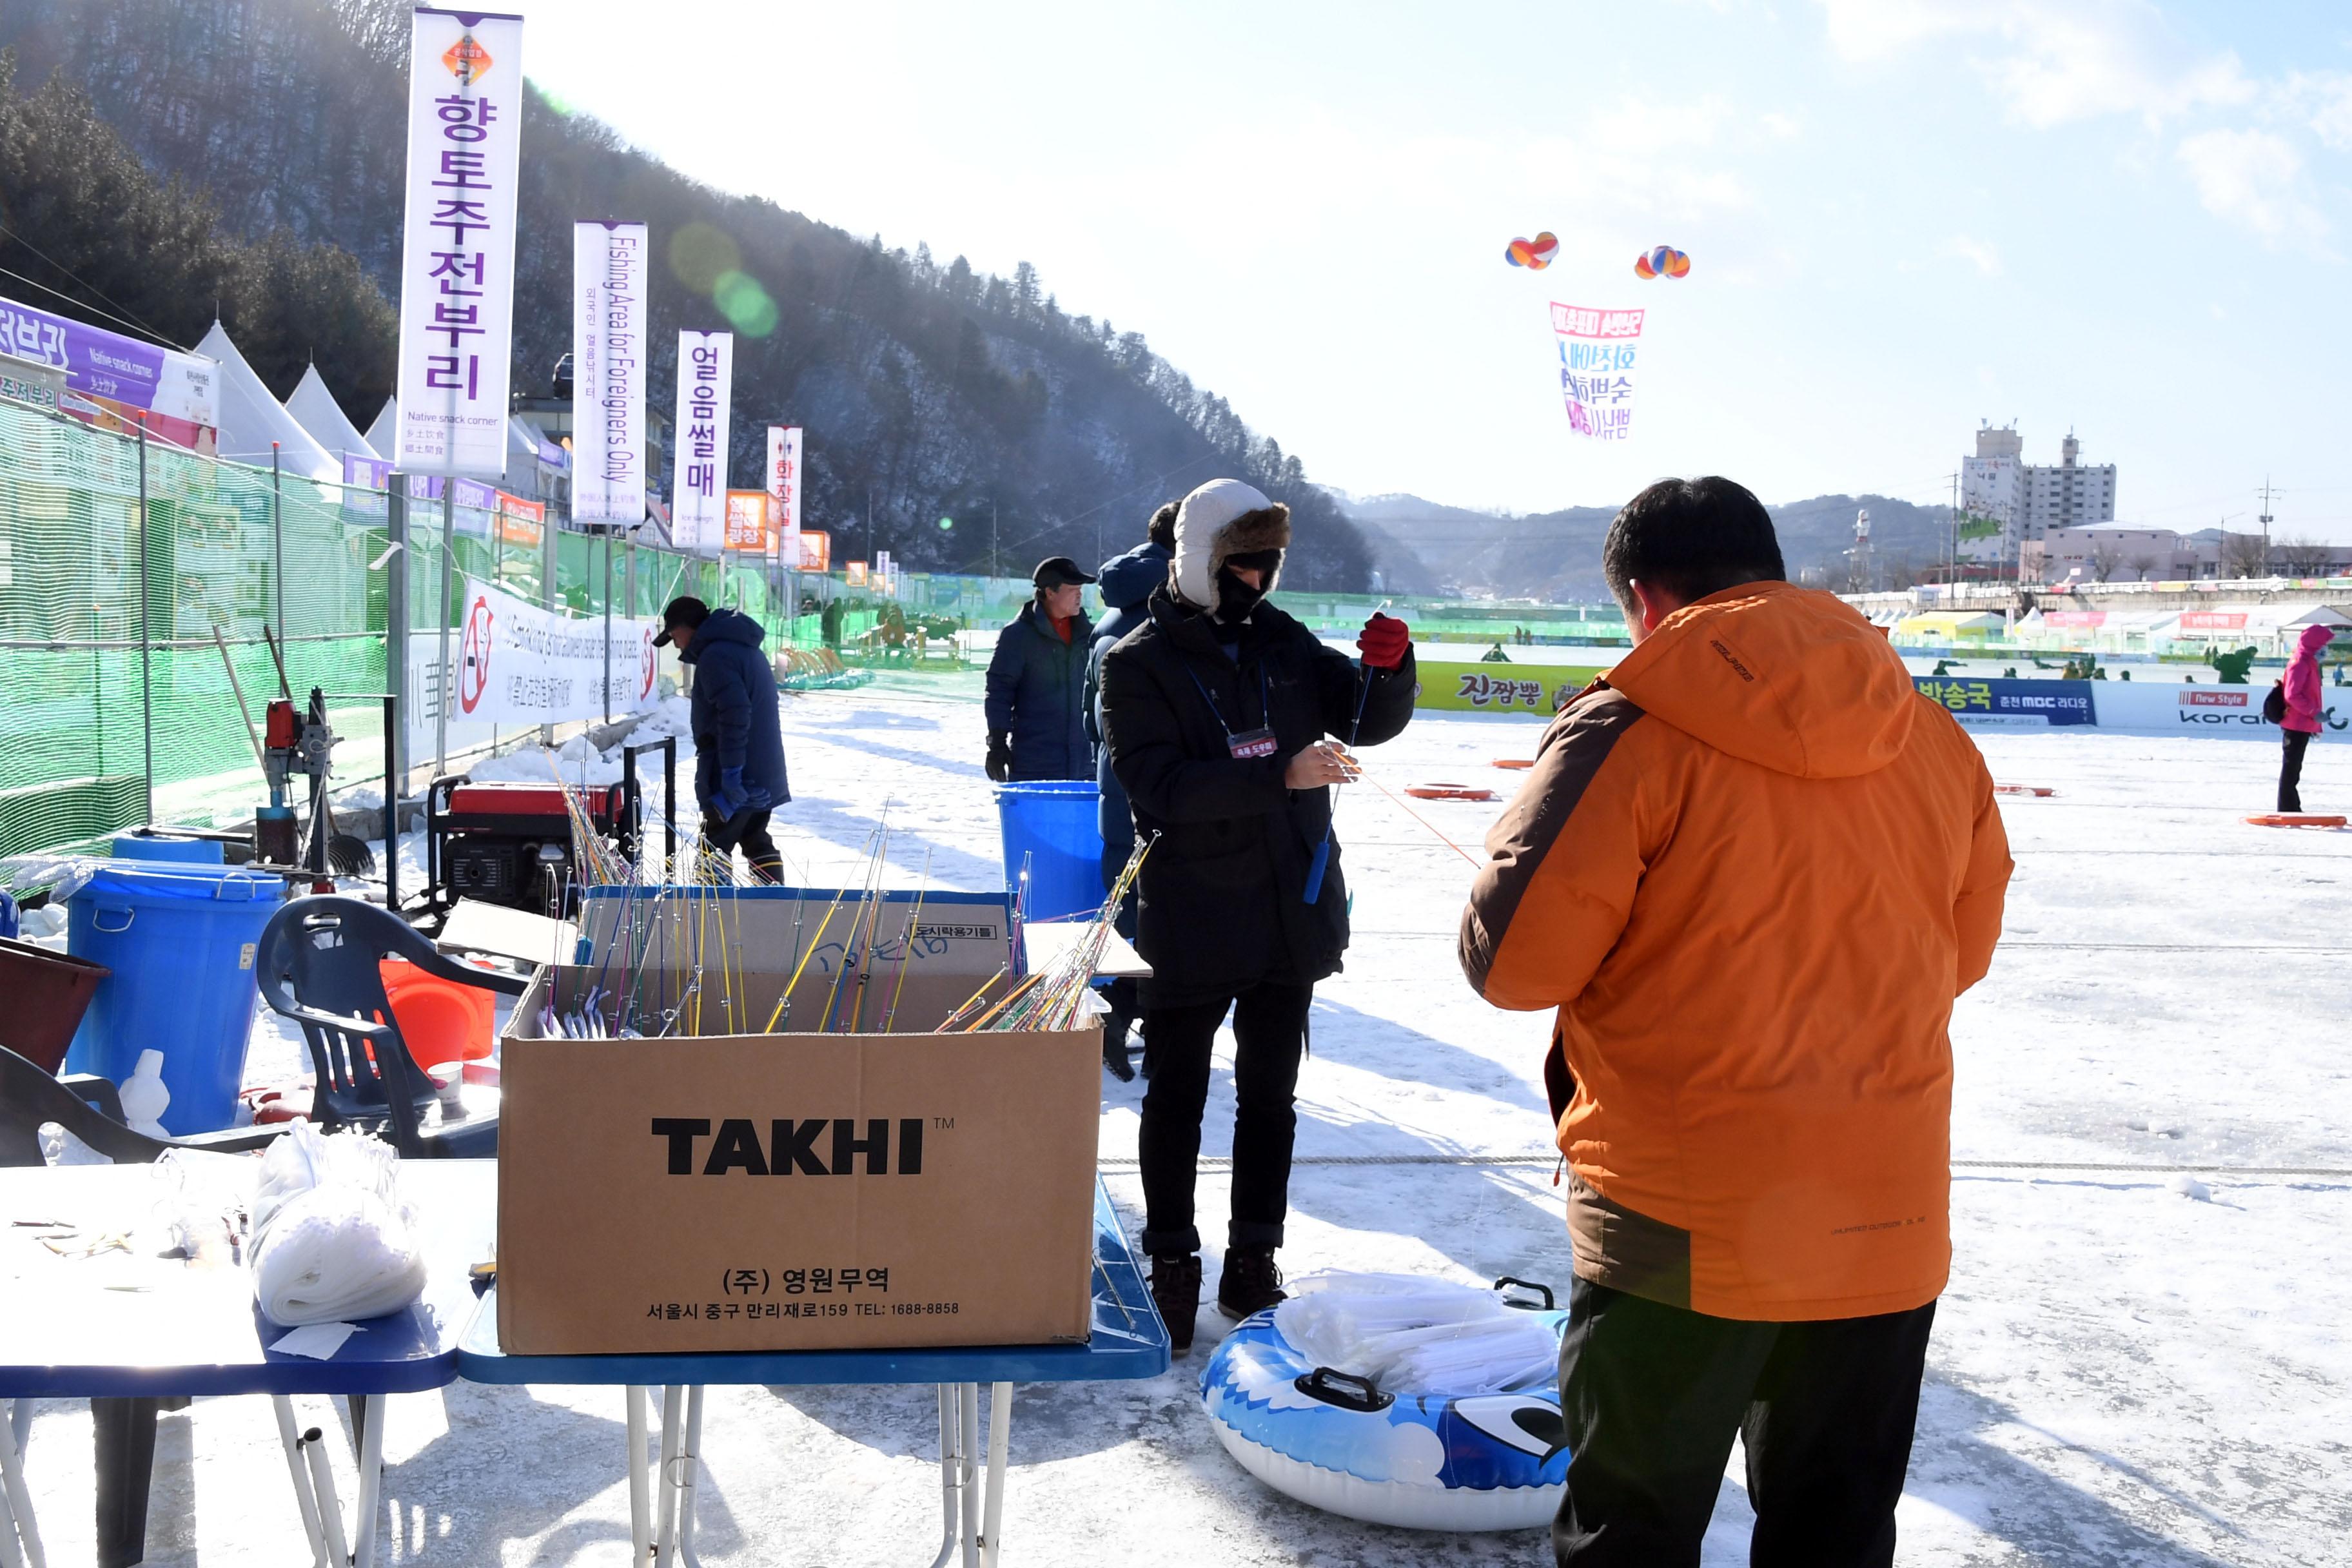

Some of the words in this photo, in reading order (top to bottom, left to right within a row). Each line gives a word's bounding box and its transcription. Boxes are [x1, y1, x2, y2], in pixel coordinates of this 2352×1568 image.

[426, 94, 498, 400] 향토주전부리
[602, 237, 636, 290] Fishing
[585, 288, 596, 326] 외국인
[608, 293, 636, 328] Area
[608, 333, 635, 354] for
[585, 334, 596, 398] 얼음낚시터
[407, 411, 437, 422] Native
[439, 416, 466, 424] snack
[467, 417, 498, 426] corner
[601, 358, 635, 445] Foreigners
[687, 347, 718, 497] 얼음썰매
[600, 451, 634, 484] Only
[776, 460, 794, 527] 화장실
[1456, 673, 1542, 707] 진짬뽕
[2022, 697, 2055, 708] MBC
[2057, 697, 2088, 709] 라디오
[2195, 693, 2215, 703] New
[2218, 694, 2242, 705] Style
[652, 1118, 923, 1175] TAKHI
[934, 1117, 954, 1130] TM
[723, 1268, 770, 1295] (주)
[783, 1268, 889, 1295] 영원무역
[647, 1303, 699, 1320] 서울시
[705, 1303, 741, 1320] 중구
[747, 1302, 848, 1319] 만리재로159
[855, 1304, 885, 1316] TEL:
[892, 1302, 959, 1316] 1688-8858
